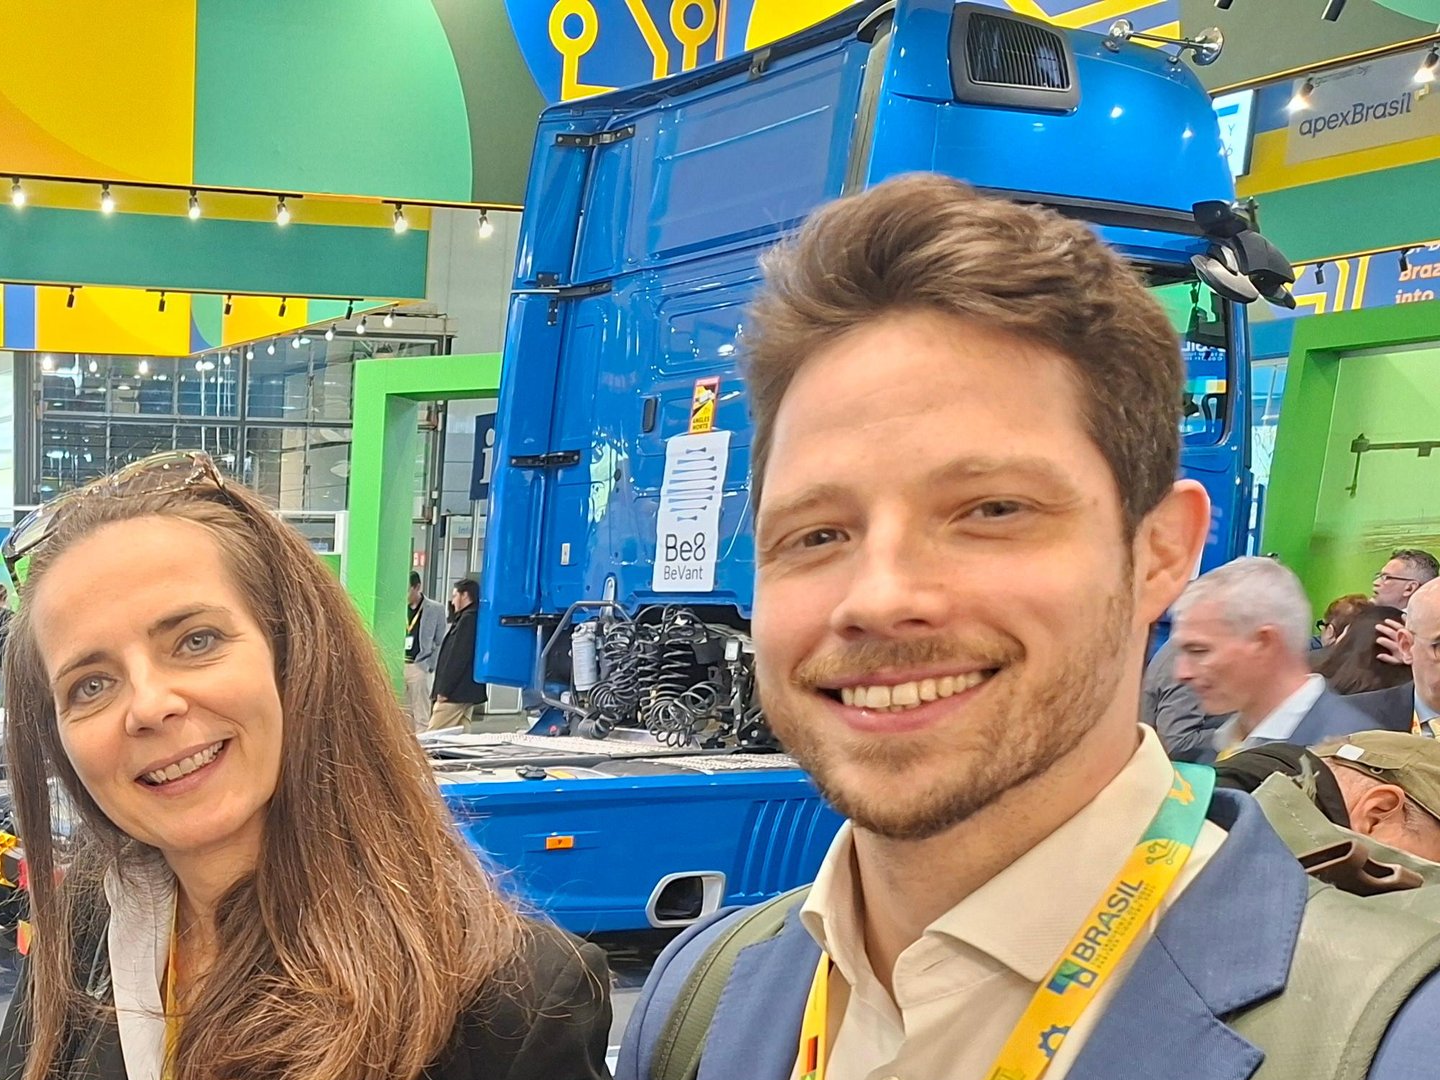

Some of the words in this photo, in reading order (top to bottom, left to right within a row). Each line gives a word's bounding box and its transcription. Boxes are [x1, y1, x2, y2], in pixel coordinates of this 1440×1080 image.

[1299, 92, 1412, 138] apexBrasil
[692, 416, 710, 424] ANGLES
[692, 423, 709, 431] MORTS
[664, 532, 706, 562] Be8
[663, 565, 703, 581] BeVant
[1071, 879, 1144, 963] BRASIL
